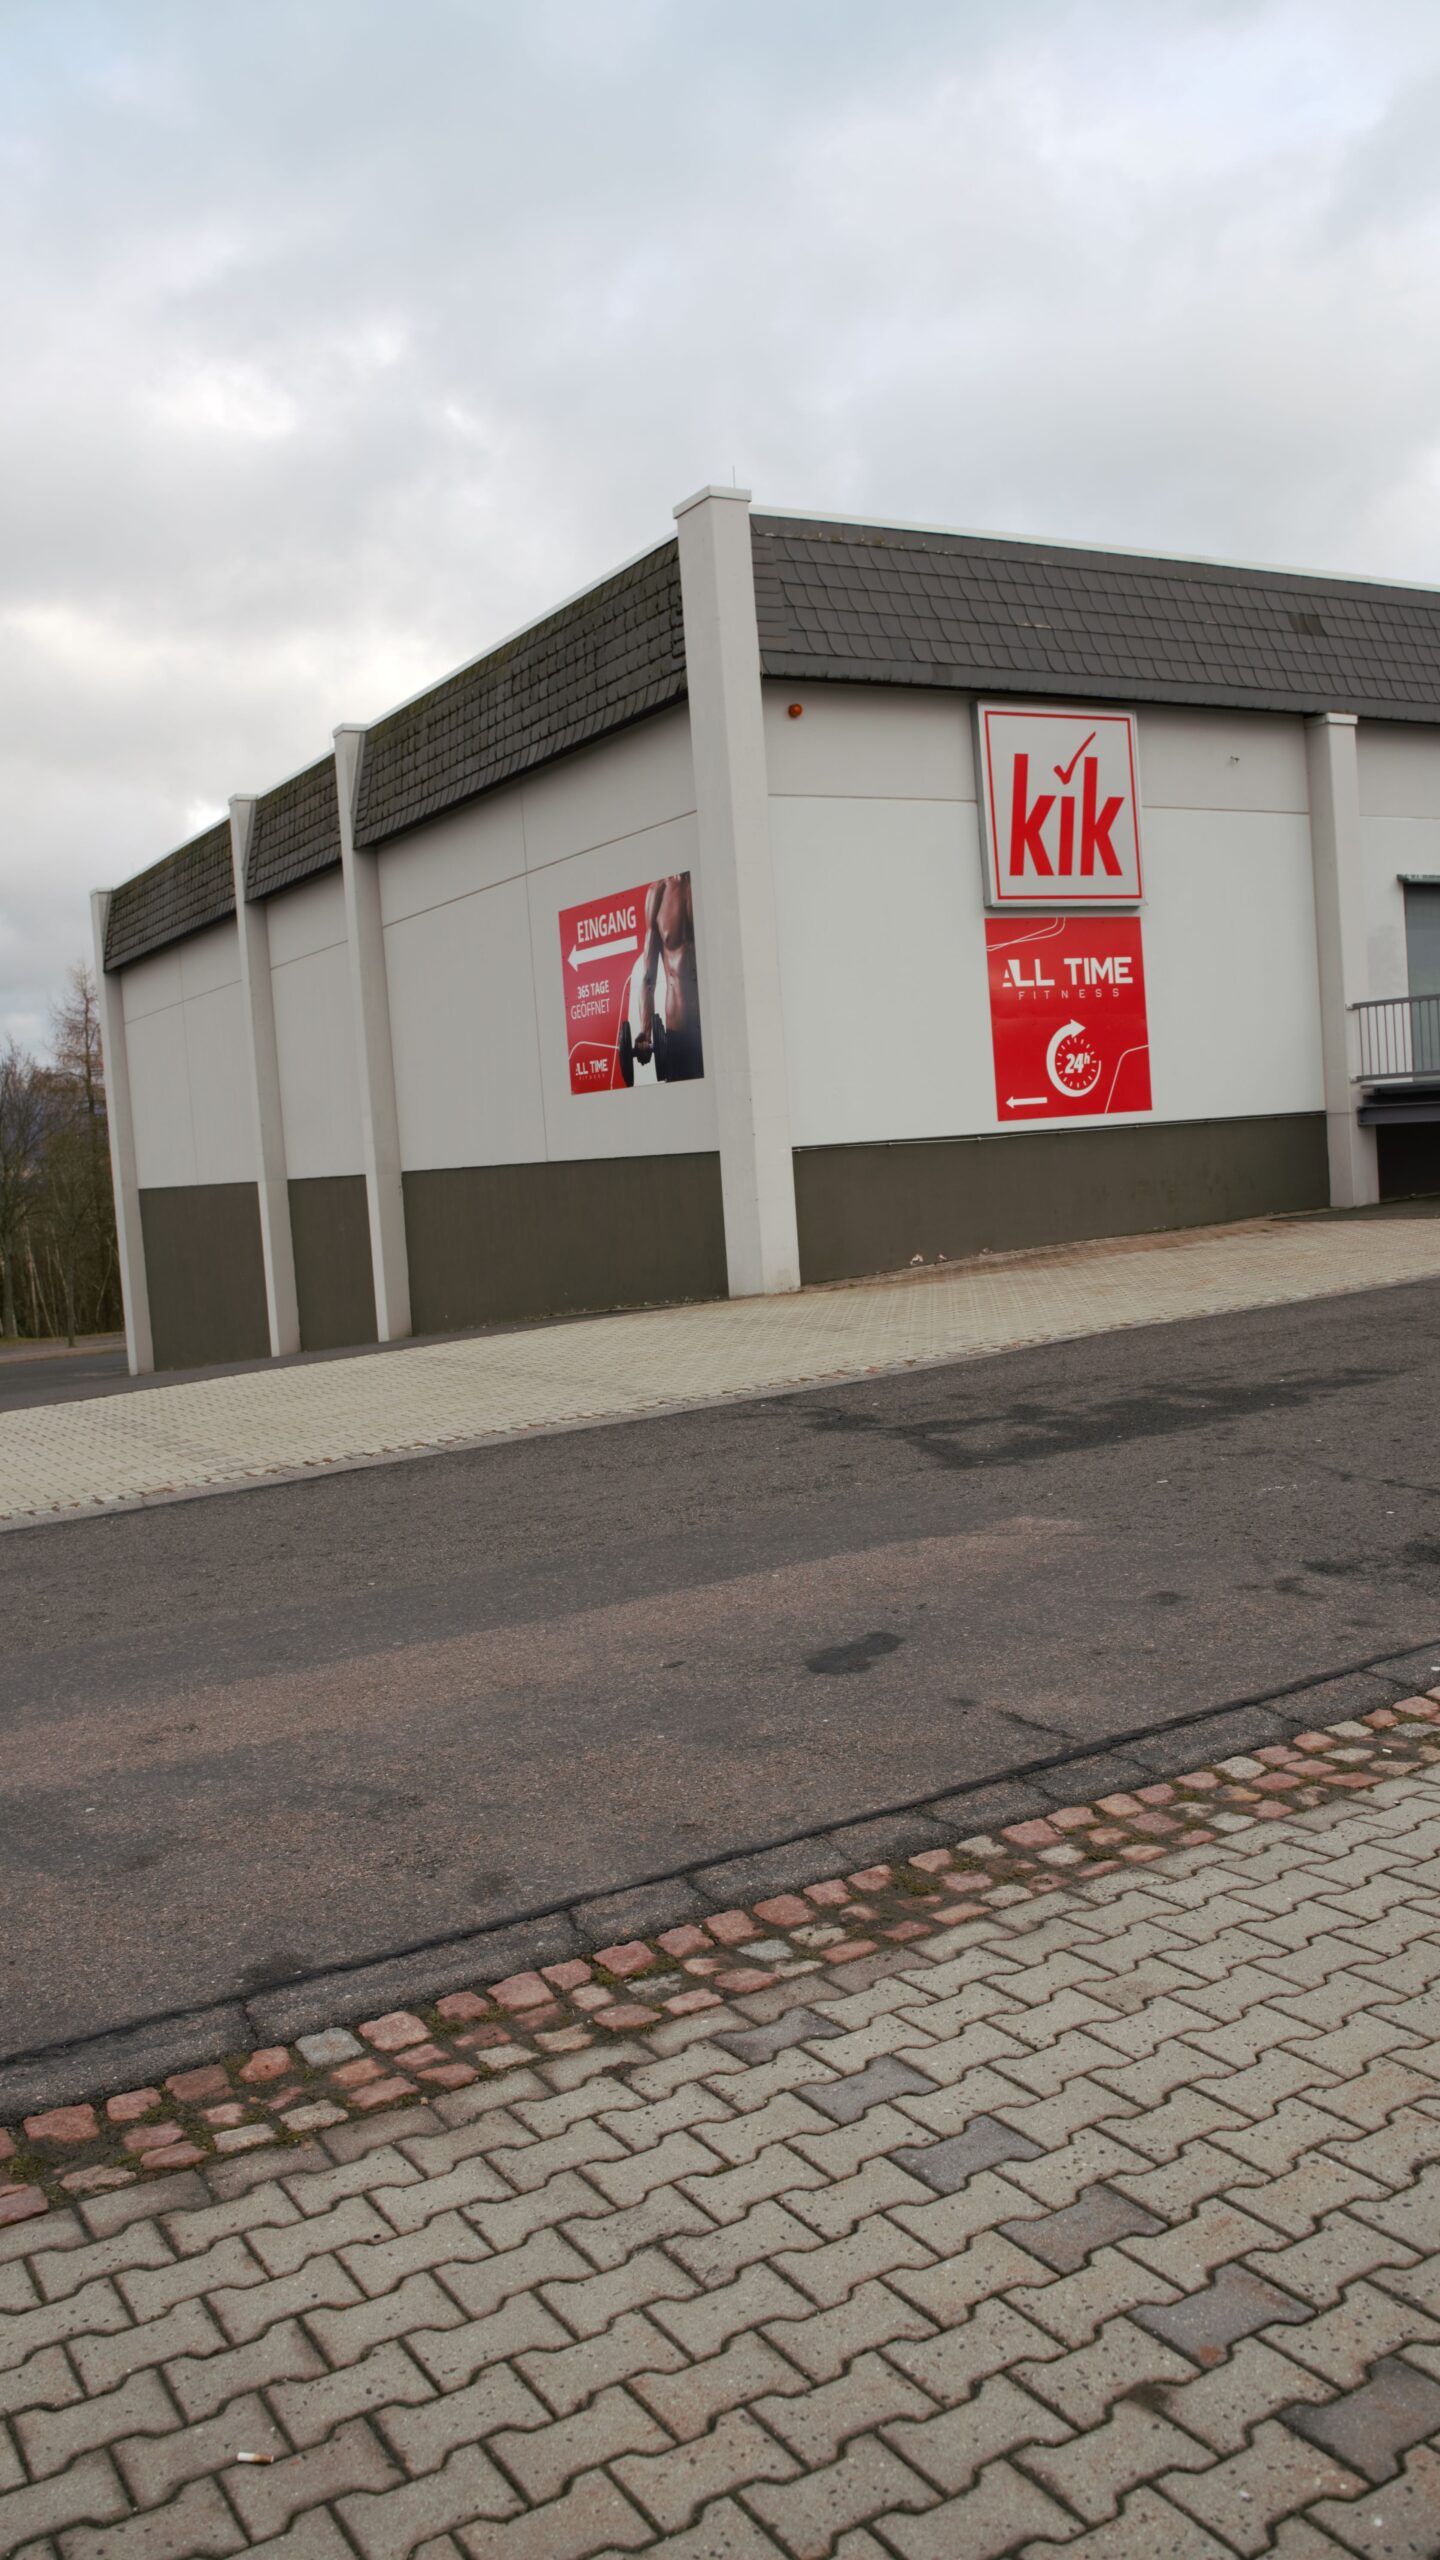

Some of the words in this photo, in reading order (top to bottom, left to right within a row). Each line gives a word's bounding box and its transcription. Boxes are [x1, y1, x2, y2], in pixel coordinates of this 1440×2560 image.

[577, 906, 637, 943] EINGANG
[1002, 958, 1055, 987] ALL
[1064, 956, 1133, 985] TIME
[577, 984, 590, 999] 365
[590, 980, 609, 996] TAGE
[1018, 988, 1120, 1000] FITNESS
[571, 998, 610, 1020] GEÖFFNET
[589, 1058, 608, 1073] TIME
[1065, 1052, 1090, 1074] 24h
